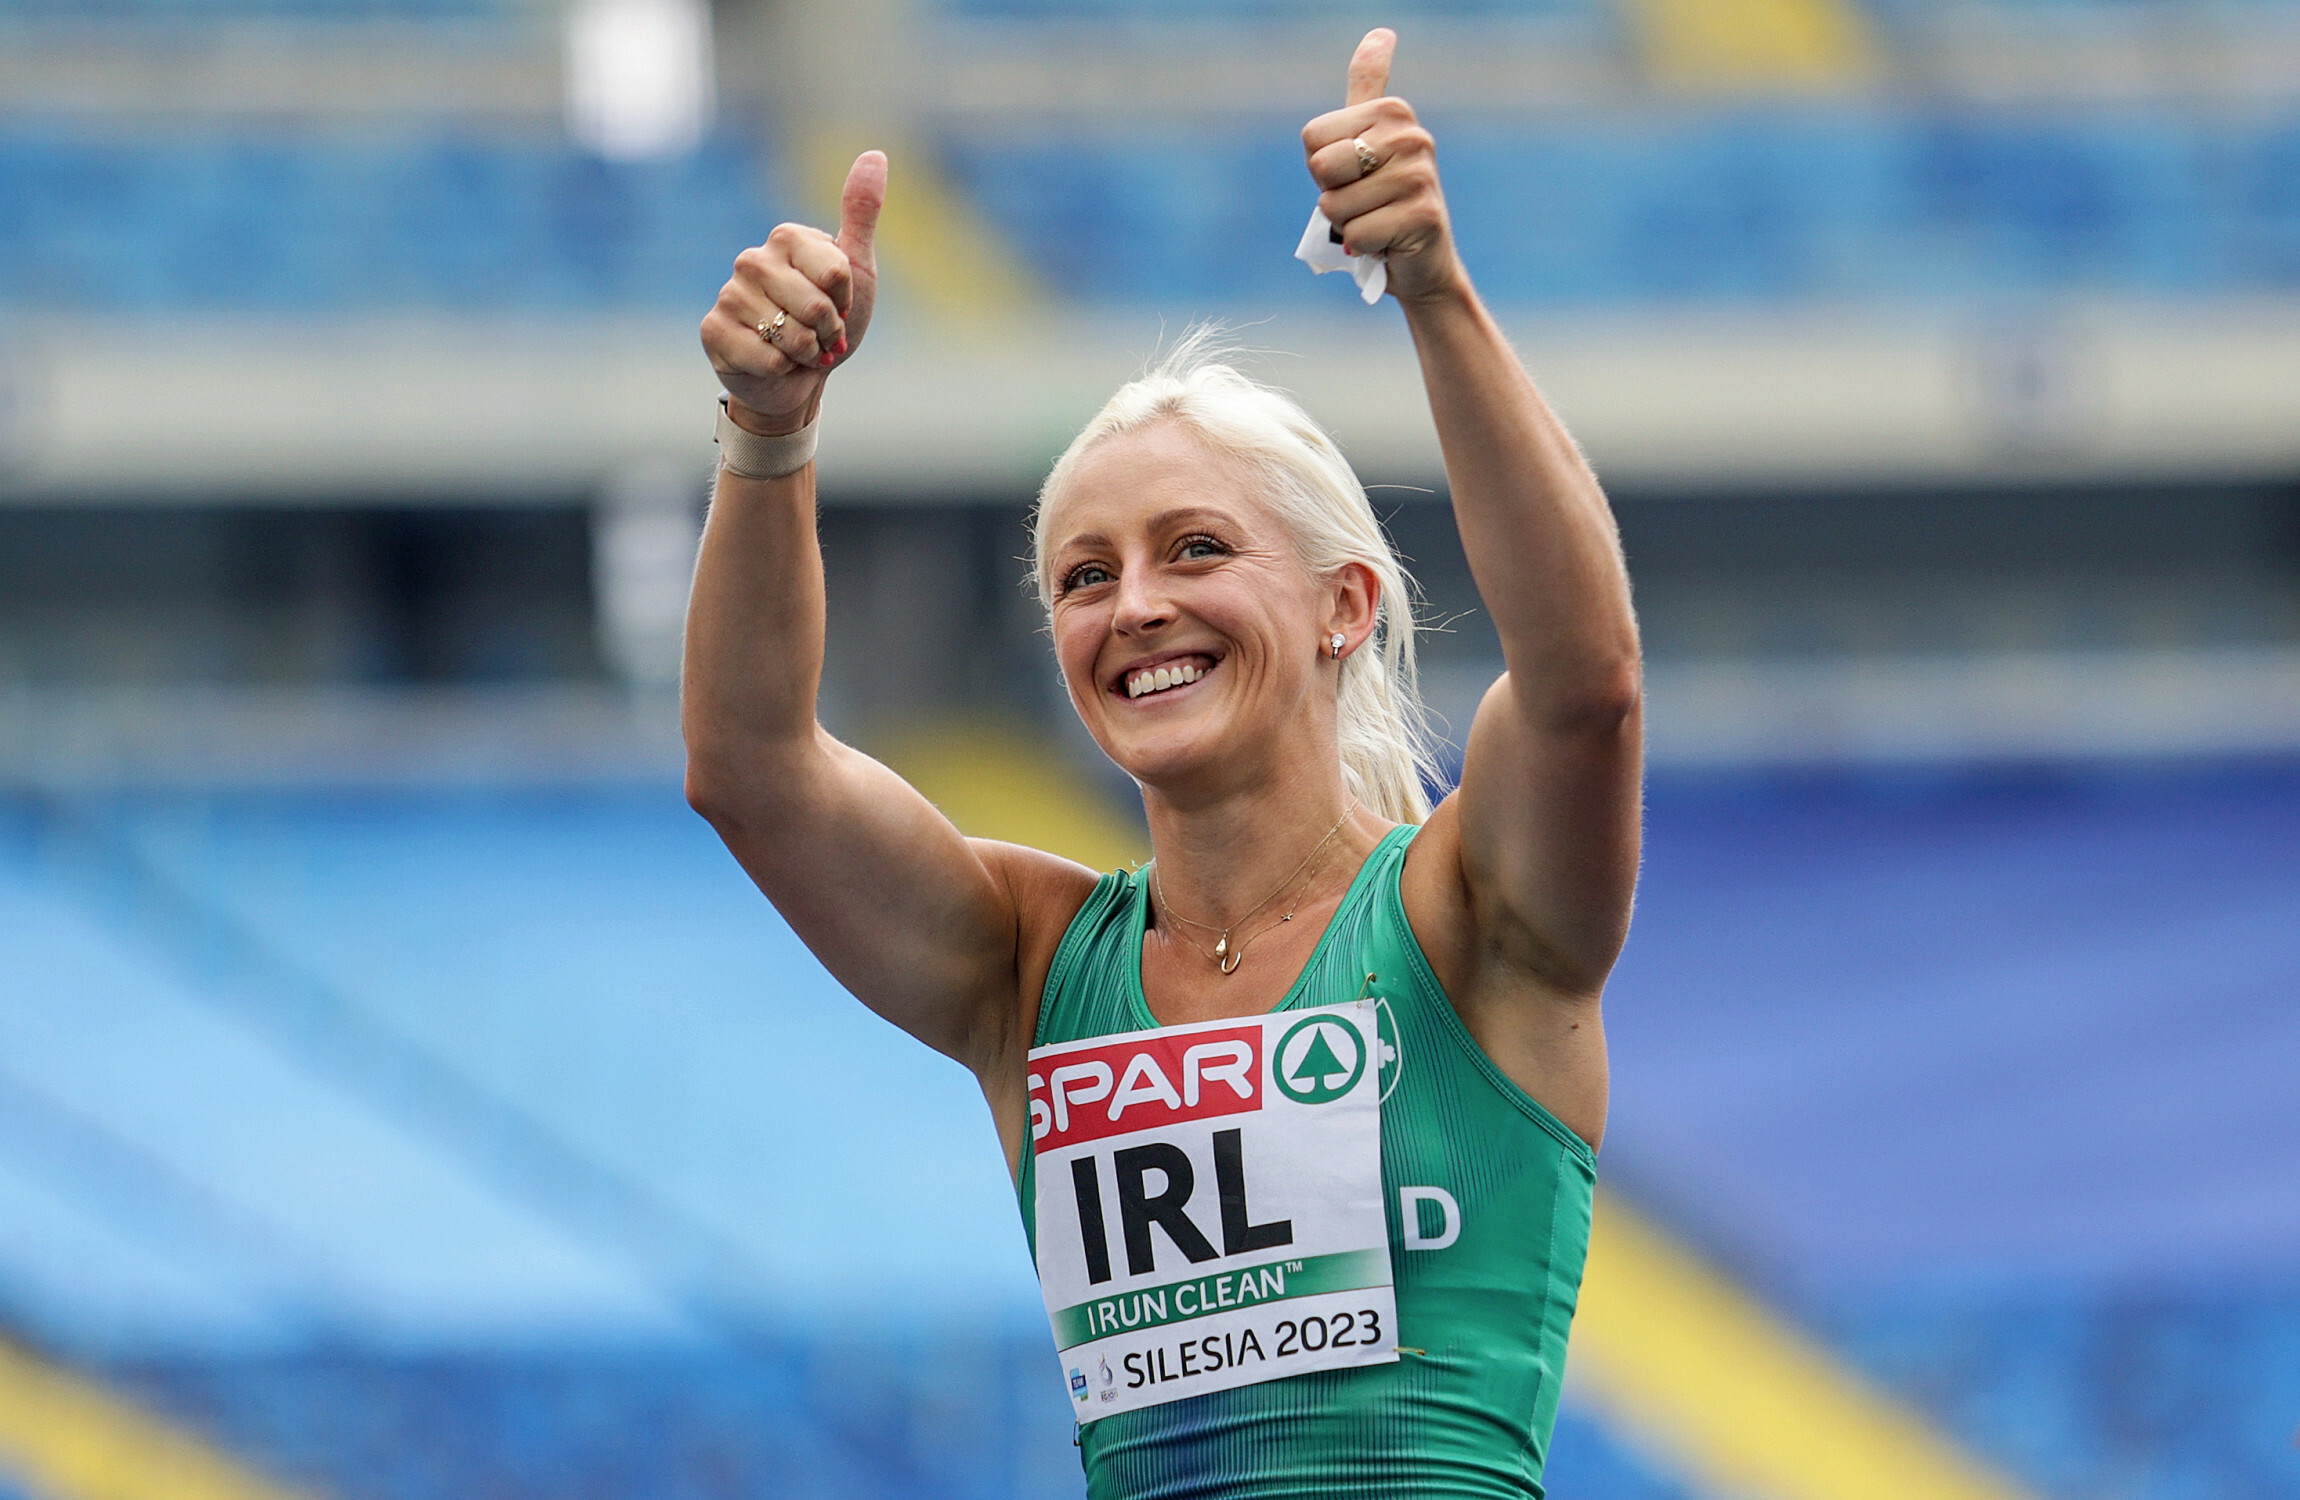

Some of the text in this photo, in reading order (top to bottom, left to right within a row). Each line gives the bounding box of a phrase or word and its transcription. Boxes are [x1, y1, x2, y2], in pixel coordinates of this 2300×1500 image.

[1071, 1128, 1293, 1286] IRL
[1123, 1310, 1381, 1389] SILESIA 2023
